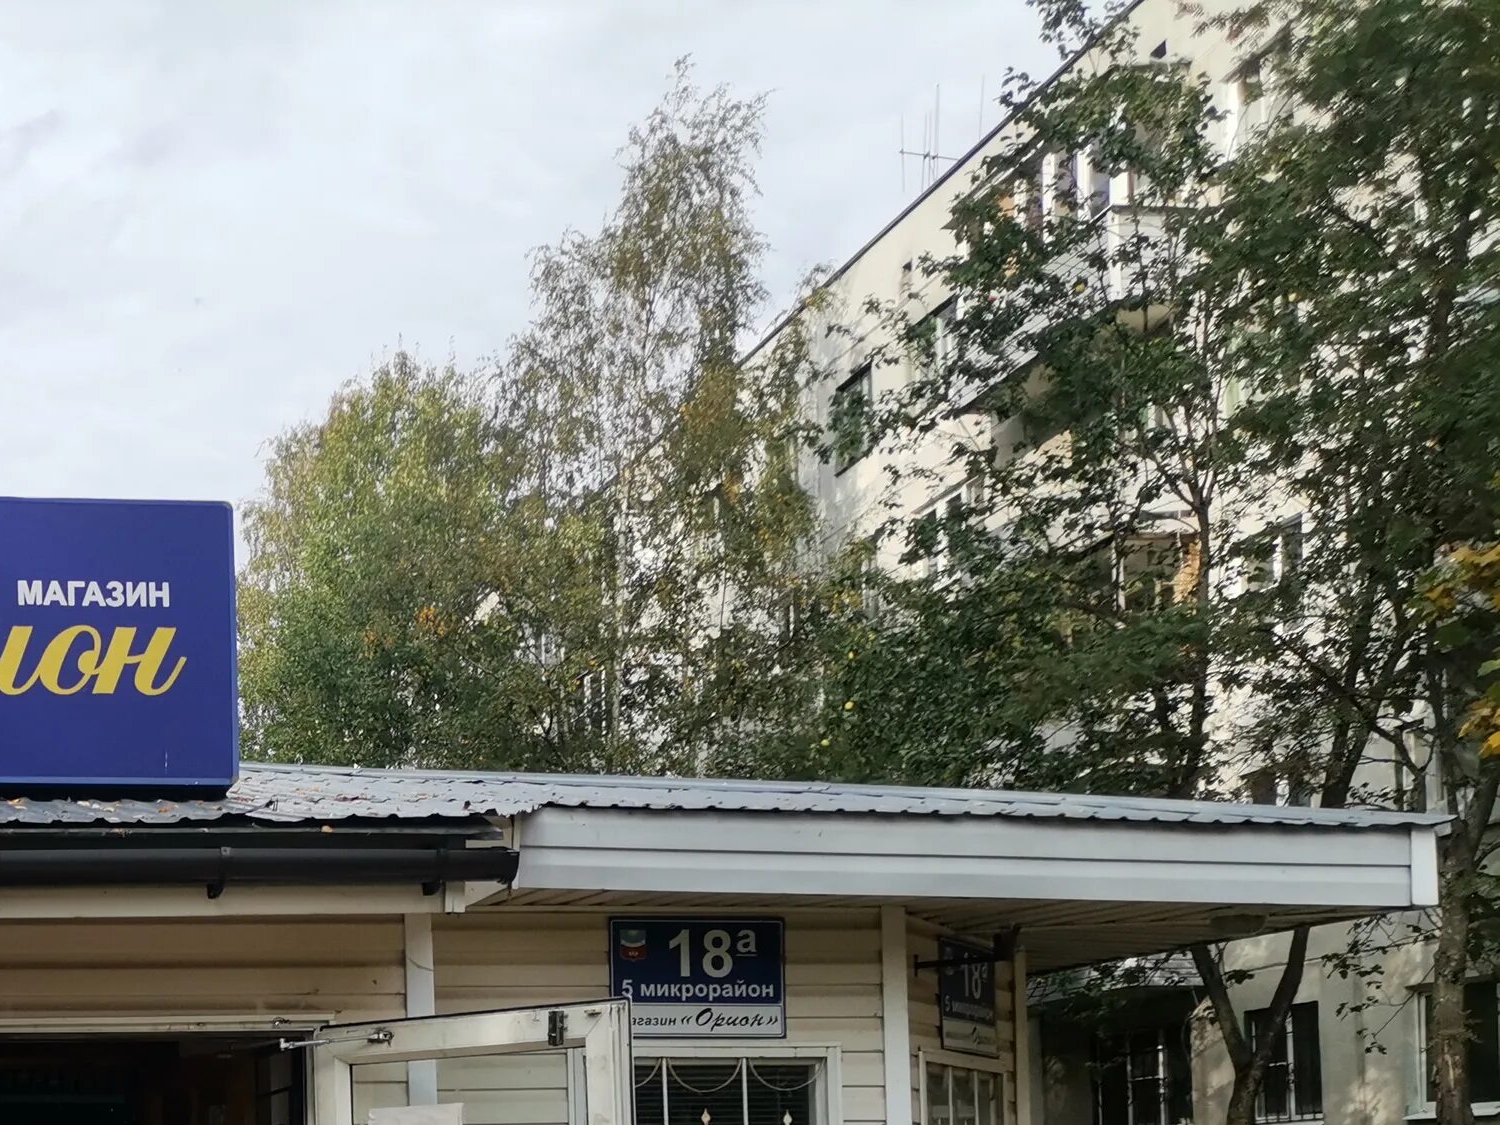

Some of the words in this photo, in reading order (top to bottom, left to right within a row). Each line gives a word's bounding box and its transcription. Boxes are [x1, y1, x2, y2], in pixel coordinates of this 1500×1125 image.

[17, 579, 171, 608] МАГАЗИН
[621, 978, 634, 998] 5
[640, 979, 775, 1001] микрорайон
[632, 1016, 677, 1027] агазин
